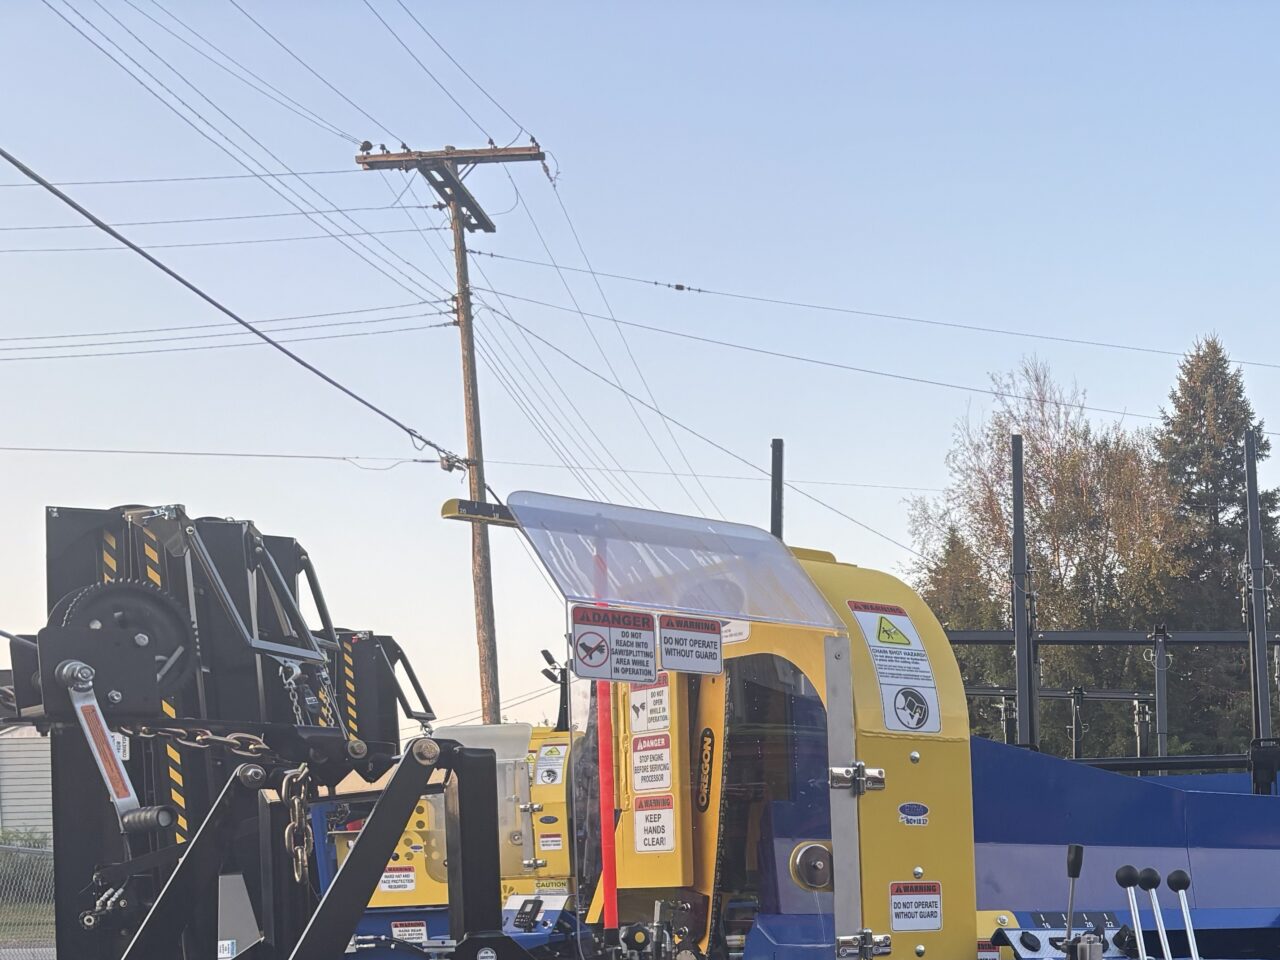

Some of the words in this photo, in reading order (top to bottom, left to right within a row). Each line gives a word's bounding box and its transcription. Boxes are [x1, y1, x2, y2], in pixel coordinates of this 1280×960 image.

[592, 611, 650, 628] DANGER
[675, 619, 716, 631] WARNING
[630, 632, 642, 640] NOT
[615, 639, 634, 648] REACH
[635, 641, 649, 649] INTO
[664, 637, 673, 645] DO
[674, 637, 687, 647] NOT
[689, 639, 718, 649] OPERATE
[664, 648, 694, 658] WITHOUT
[695, 650, 718, 660] GUARD
[616, 658, 630, 666] AREA
[631, 659, 650, 667] WHILE
[613, 666, 620, 674] IN
[643, 738, 665, 748] DANGER
[639, 755, 649, 763] STOP
[649, 753, 664, 762] ENGINE
[634, 765, 649, 774] BEFORE
[649, 763, 670, 773] SERVICING
[699, 736, 712, 807] OREGON
[640, 774, 664, 783] PROCESSOR
[644, 798, 670, 808] WARNING
[645, 813, 662, 823] KEEP
[643, 825, 666, 835] HANDS
[643, 837, 666, 847] CLEAR!
[903, 885, 937, 893] WARNING
[902, 901, 913, 909] NOT
[914, 900, 938, 909] OPERATE
[895, 911, 918, 919] WITHOUT
[919, 910, 938, 919] GUARD
